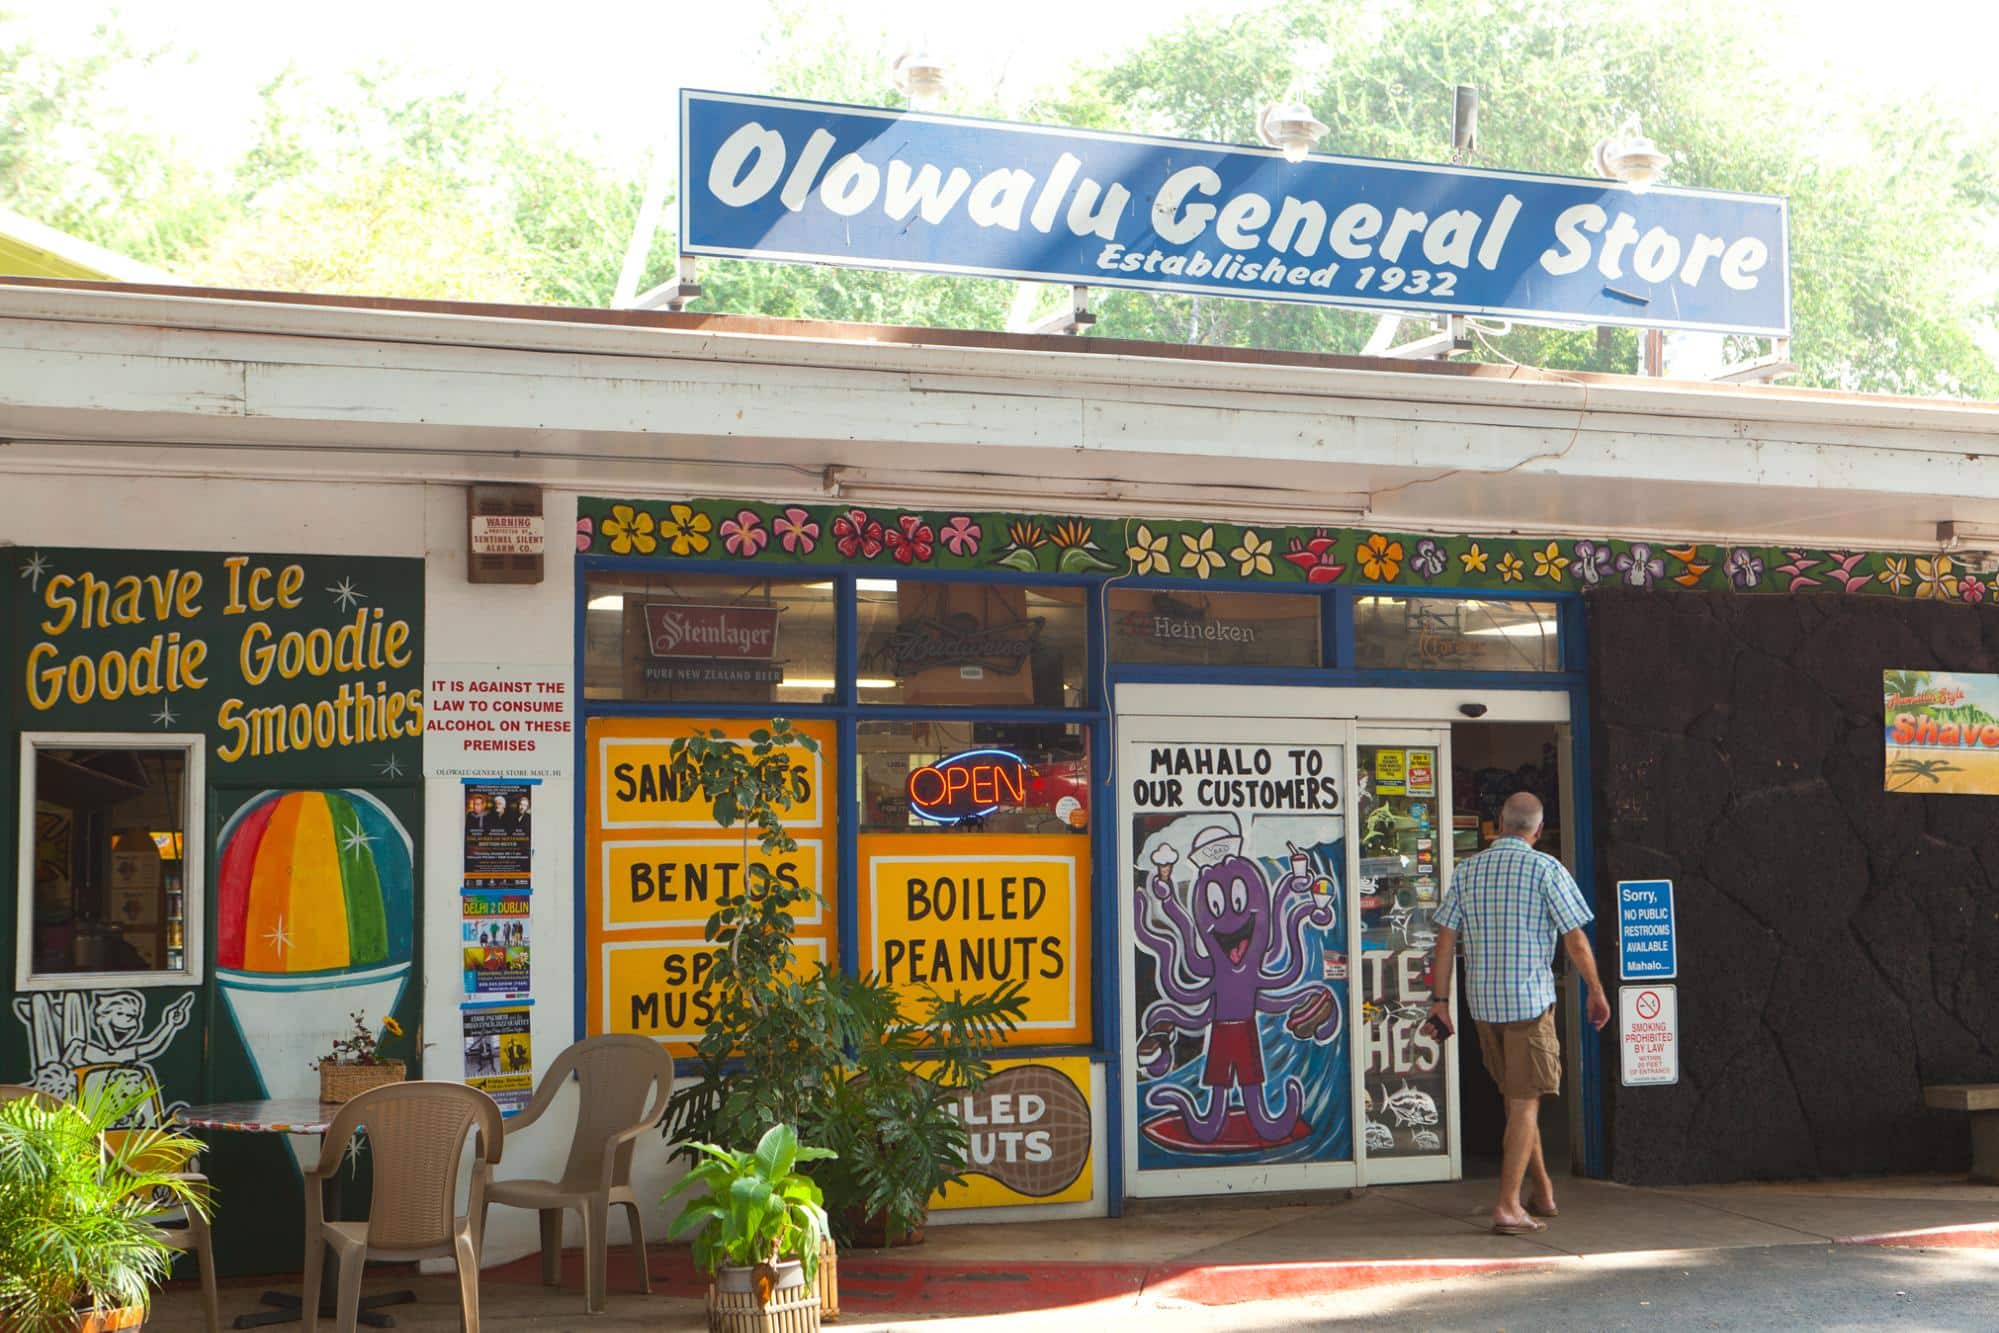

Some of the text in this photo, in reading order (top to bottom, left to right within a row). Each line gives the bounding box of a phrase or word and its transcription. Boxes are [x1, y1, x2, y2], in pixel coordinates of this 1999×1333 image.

[708, 121, 1768, 291] Olowalu General Store
[1096, 242, 1458, 298] Established 1932
[486, 518, 531, 527] WARNING
[474, 536, 543, 544] SENTINEL SILENT
[486, 545, 515, 553] ALARM
[41, 556, 305, 636] Shave Ice
[656, 609, 771, 654] Steinlager
[1152, 616, 1255, 643] Heineken
[240, 607, 413, 686] Goodie
[26, 632, 208, 711] Goodie
[647, 667, 780, 681] PURE NEW ZEALAND BEER
[432, 680, 565, 693] IT IS AGAINST THE
[433, 700, 564, 712] LAW TO CONSUME
[216, 681, 424, 763] Smoothies
[426, 719, 571, 732] ALCOHOL ON THESE
[1892, 712, 1999, 747] Shave
[463, 739, 536, 752] PREMISES
[1150, 748, 1322, 776] MAHALO TO
[911, 764, 1024, 806] OPEN
[1133, 777, 1339, 810] OUR CUSTOMERS
[631, 862, 801, 903] BENTOS
[907, 877, 1046, 921] BOILED
[1623, 889, 1657, 903] Sorry,
[463, 902, 488, 914] DELHI
[498, 902, 529, 913] DUBLIN
[1624, 908, 1668, 920] NO PUBLIC
[1624, 924, 1670, 936] RESTROOMS
[1626, 941, 1668, 953] AVAILABLE
[884, 936, 1064, 983] PEANUTS
[1631, 1022, 1667, 1033] SMOKING
[1625, 1032, 1673, 1044] PROHIBITED
[1634, 1042, 1665, 1053] BY LAW
